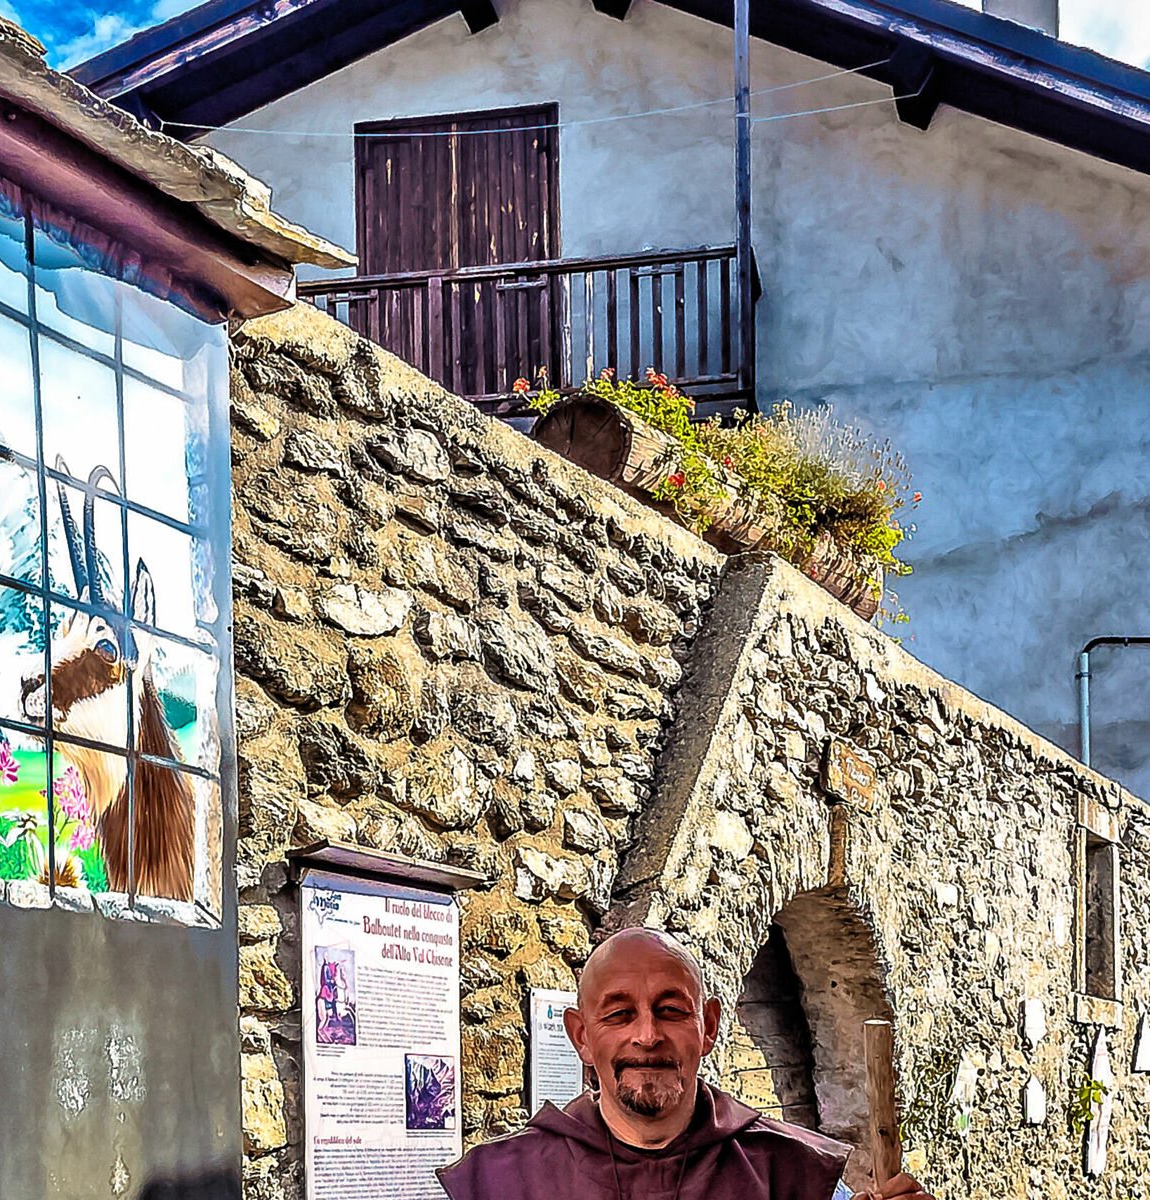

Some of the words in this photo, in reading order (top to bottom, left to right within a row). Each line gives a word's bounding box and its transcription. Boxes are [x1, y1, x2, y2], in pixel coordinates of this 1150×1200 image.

[411, 903, 422, 918] del
[363, 915, 401, 938] Balboutet
[403, 925, 420, 941] nella
[421, 931, 453, 947] conquista
[426, 949, 453, 967] Chisone
